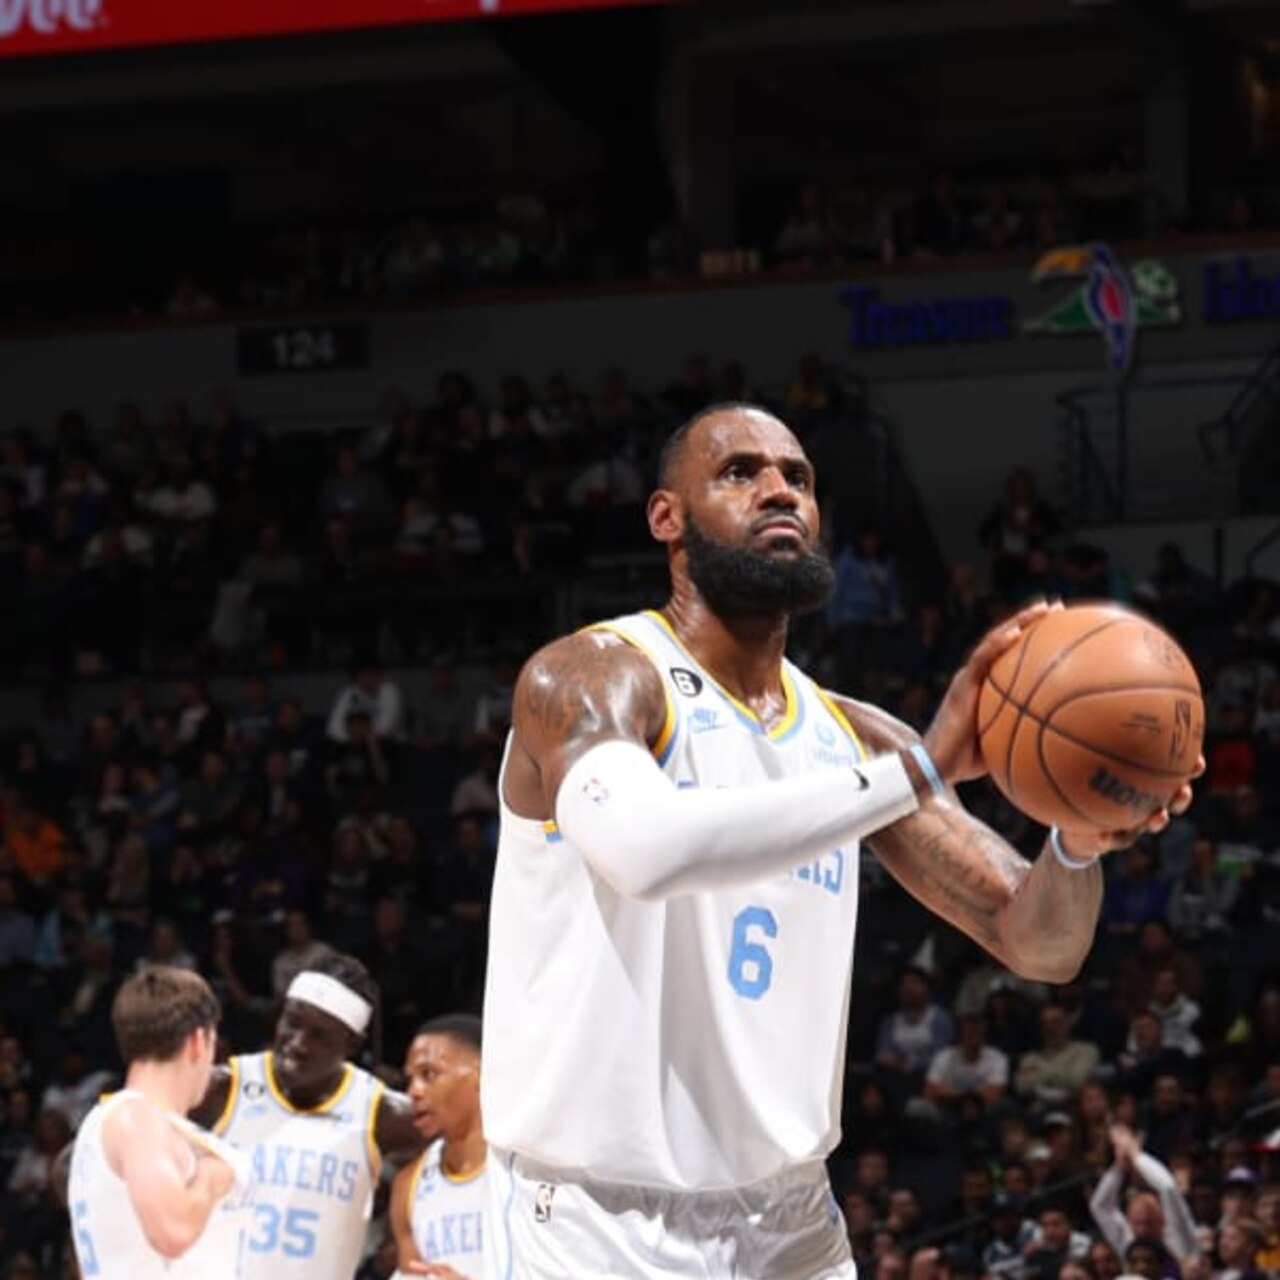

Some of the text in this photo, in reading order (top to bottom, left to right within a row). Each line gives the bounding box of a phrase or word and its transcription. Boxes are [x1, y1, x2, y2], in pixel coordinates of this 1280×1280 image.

[841, 284, 1014, 350] Treasure
[272, 327, 337, 369] 124
[726, 905, 778, 1000] 6
[253, 1143, 359, 1202] AKERS
[248, 1202, 320, 1260] 35
